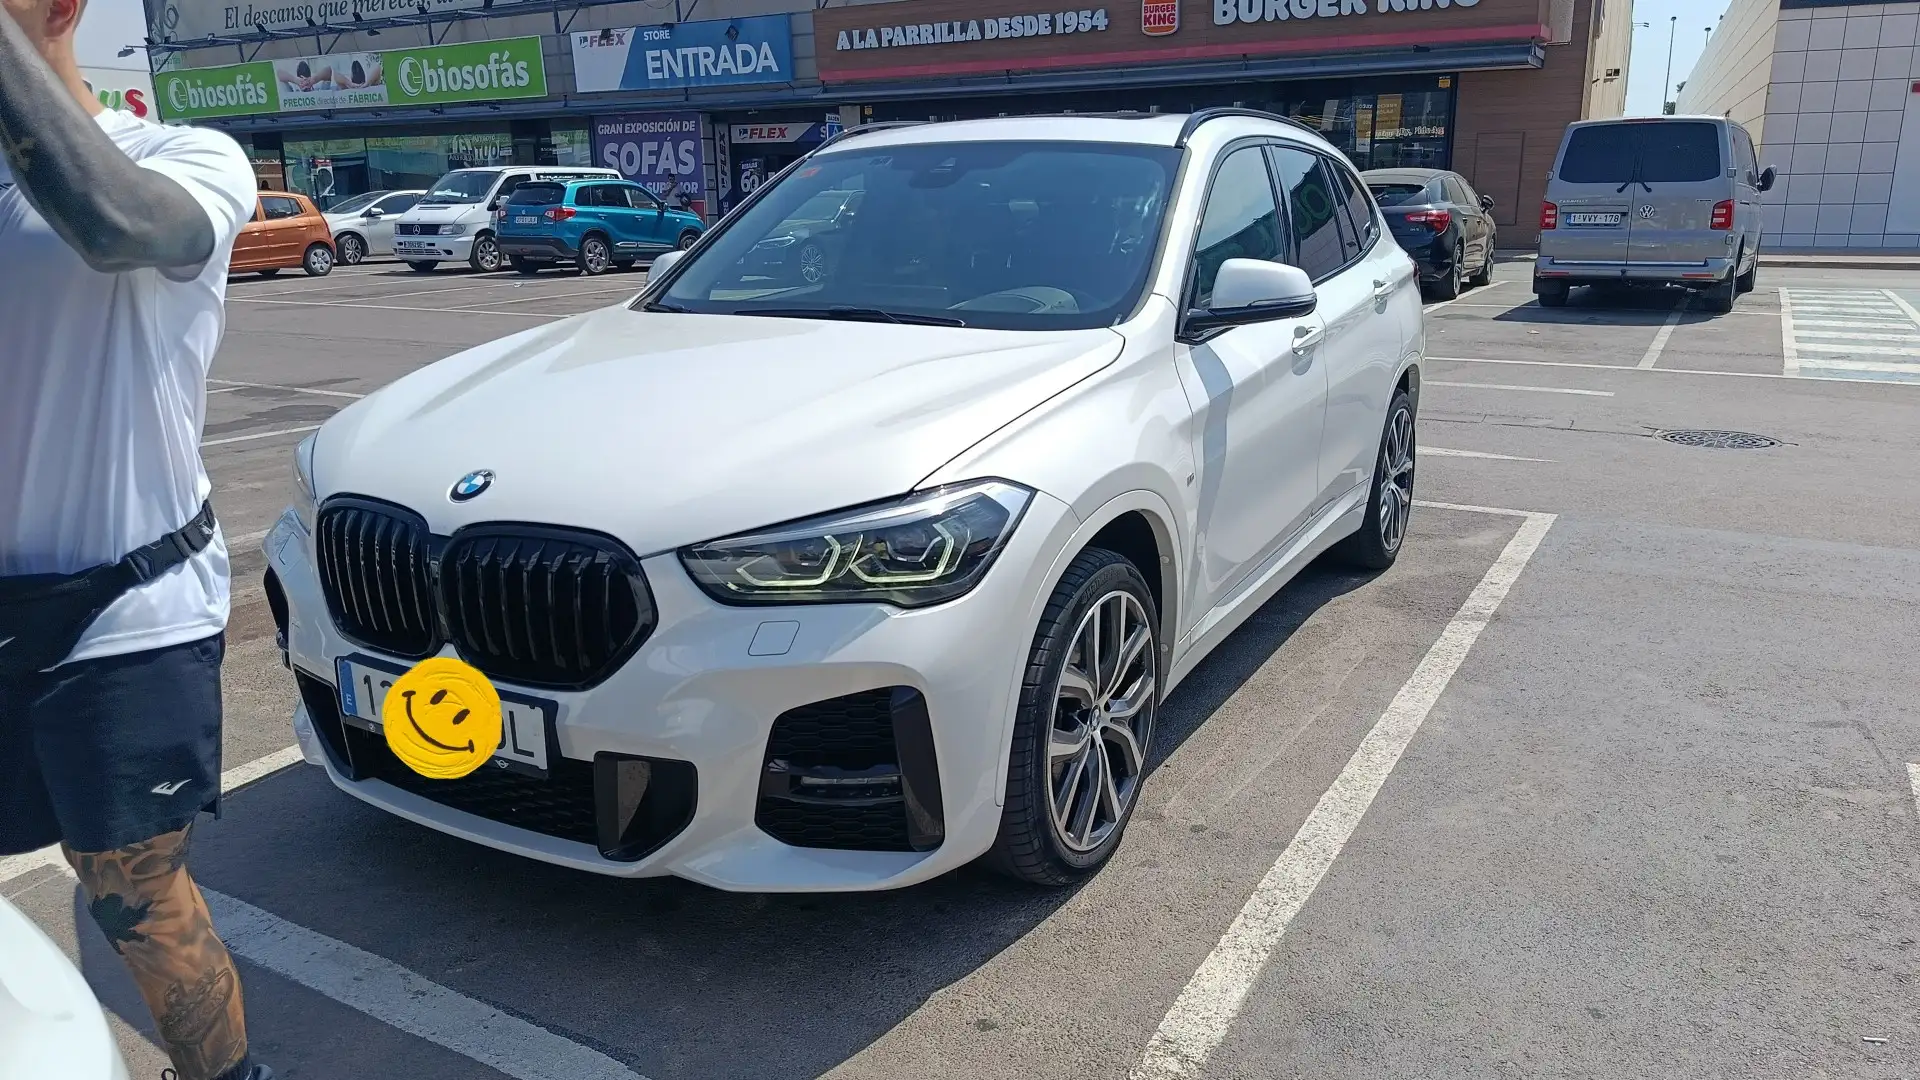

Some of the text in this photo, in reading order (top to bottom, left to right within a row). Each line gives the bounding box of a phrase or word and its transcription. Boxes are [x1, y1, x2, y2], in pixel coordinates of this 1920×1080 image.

[225, 7, 239, 29] El
[244, 5, 314, 27] descanso
[319, 1, 348, 25] que
[1144, 4, 1176, 13] BURGER
[1144, 13, 1176, 26] KING
[589, 32, 626, 48] FLEX
[643, 29, 671, 41] STORE
[837, 9, 1108, 50] A LA PARRILLA DESDE 1954
[423, 50, 530, 93] biosofás
[646, 41, 779, 80] ENTRADA
[186, 73, 268, 109] biosofás
[283, 96, 316, 107] PRECIOS
[348, 92, 384, 104] FÁBRICA
[598, 118, 696, 135] GRAN EXPOSICIÓN DE
[749, 127, 788, 139] FLEX
[603, 136, 696, 176] SOFÁS
[719, 129, 728, 177] FLEX
